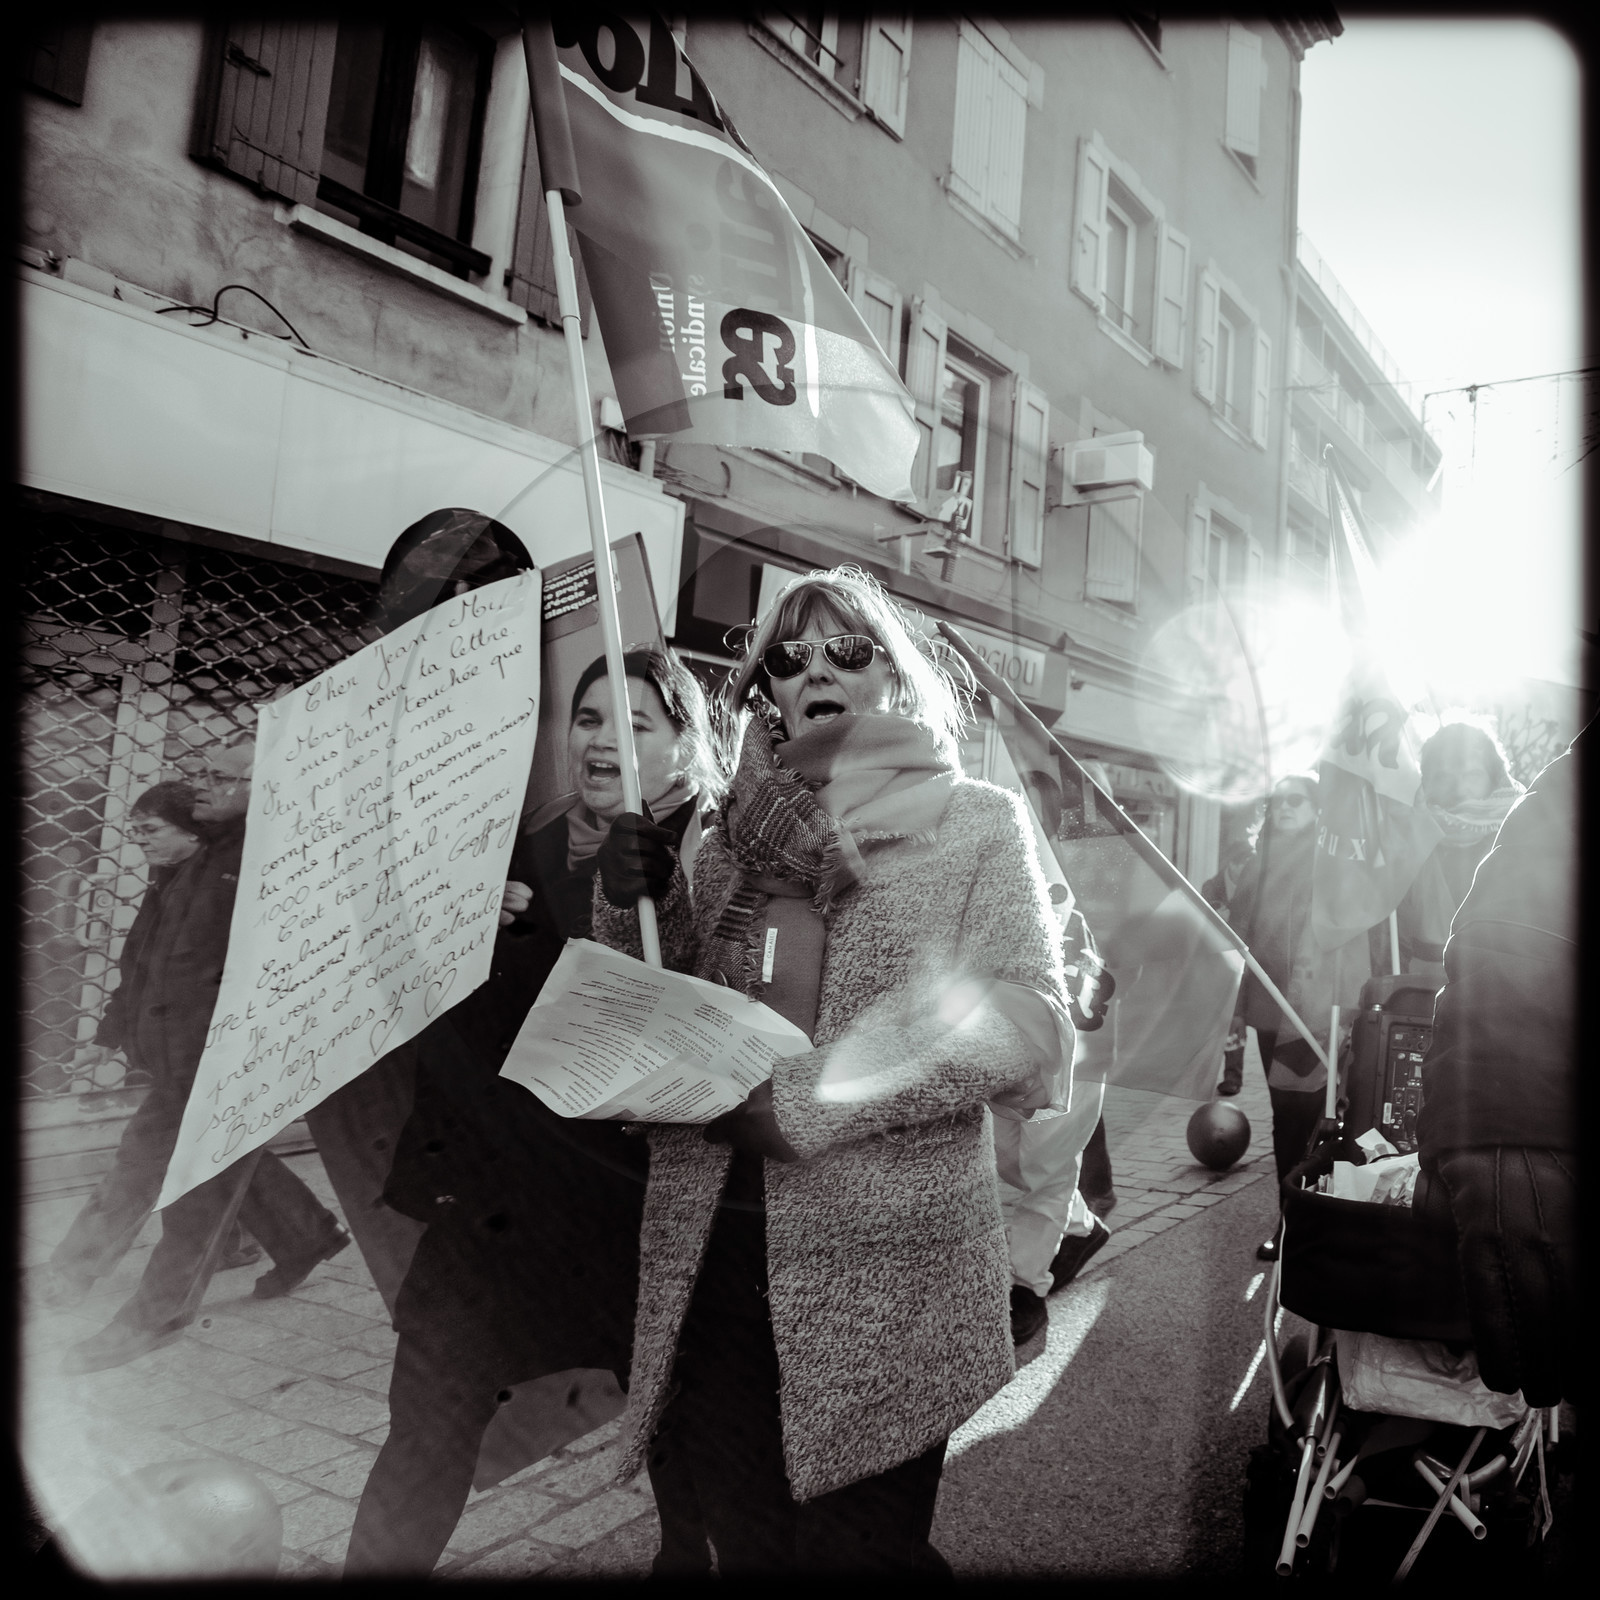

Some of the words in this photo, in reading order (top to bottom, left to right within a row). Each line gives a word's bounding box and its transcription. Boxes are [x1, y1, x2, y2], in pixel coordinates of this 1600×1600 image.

[555, 578, 589, 598] projet
[262, 780, 281, 815] Je
[295, 750, 339, 780] suis
[346, 721, 389, 749] bien
[400, 664, 480, 722] touchée
[490, 643, 522, 679] que
[285, 721, 350, 761] Merci
[361, 683, 407, 721] pour
[418, 657, 441, 681] ta
[306, 676, 358, 712] Cher
[260, 820, 346, 877] complète
[402, 740, 482, 800] personne
[270, 799, 300, 821] tu
[306, 748, 379, 811] penses
[345, 775, 383, 806] une
[390, 722, 478, 778] carrière
[256, 880, 281, 901] tu
[285, 858, 319, 885] me
[328, 806, 402, 869] promets
[414, 790, 440, 808] au
[448, 748, 507, 788] moins
[278, 902, 325, 942] C'est
[335, 882, 369, 906] très
[456, 787, 511, 828] merci
[252, 885, 311, 930] 1000
[316, 857, 365, 891] euros
[373, 828, 411, 866] par
[243, 1026, 267, 1066] Je
[279, 987, 327, 1025] vous
[336, 909, 431, 987] souhaite
[443, 882, 486, 916] une
[256, 924, 351, 989] Embrasse
[356, 911, 400, 954] pour
[196, 1083, 271, 1143] sans
[278, 1008, 375, 1093] régimes
[206, 1014, 320, 1105] prompte
[333, 984, 354, 1012] et
[366, 948, 417, 988] douce
[211, 1074, 322, 1163] Bisous
